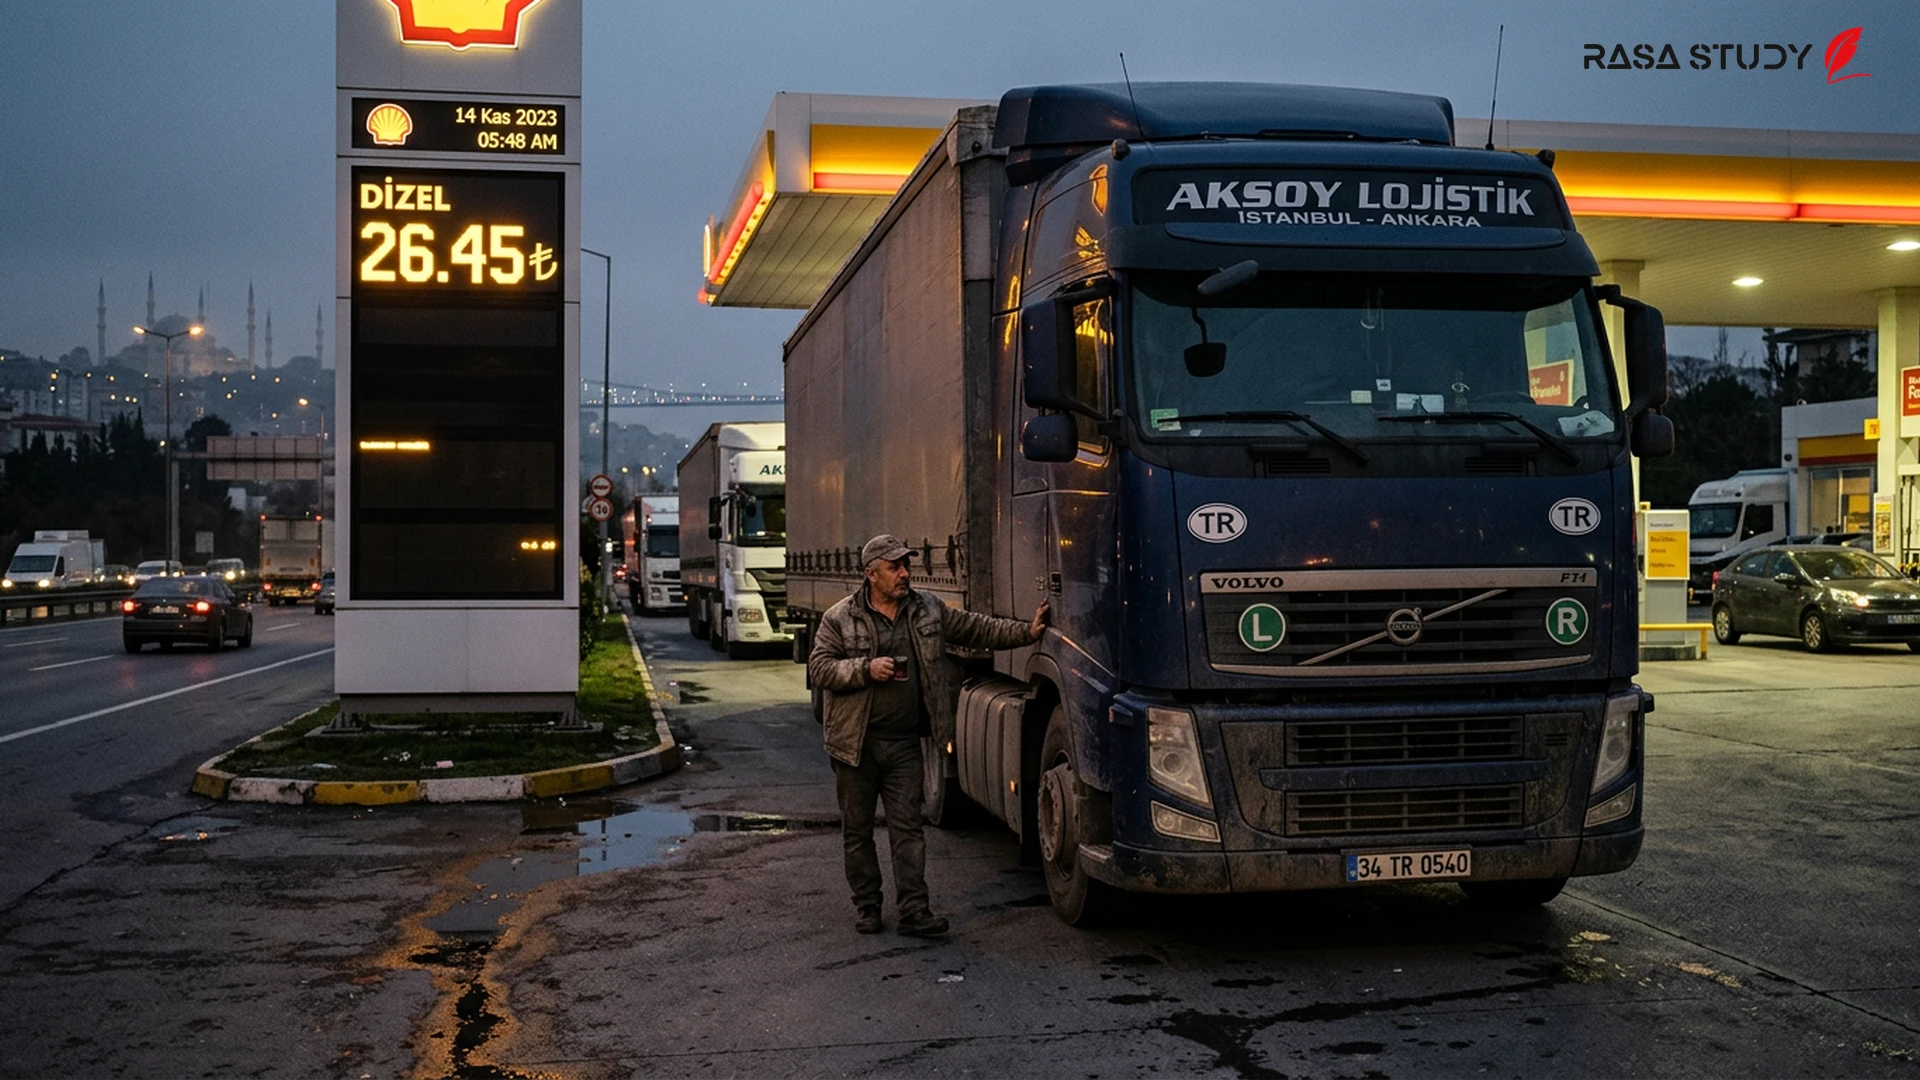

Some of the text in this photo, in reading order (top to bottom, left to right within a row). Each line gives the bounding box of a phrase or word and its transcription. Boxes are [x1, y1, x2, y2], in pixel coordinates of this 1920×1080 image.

[455, 106, 558, 126] 14 Kas 2023
[477, 131, 558, 150] 05:48 AM
[360, 176, 452, 212] DİZEL
[1165, 176, 1536, 217] AKSOY LOJİSTİK
[1380, 213, 1482, 228] ANKARA
[759, 464, 786, 475] AK
[1198, 512, 1236, 534] TR
[1557, 505, 1592, 527] TR
[1210, 576, 1285, 589] VOLVO
[1252, 612, 1273, 642] L
[1556, 606, 1580, 635] R
[1358, 852, 1468, 878] 34 TR 0540
